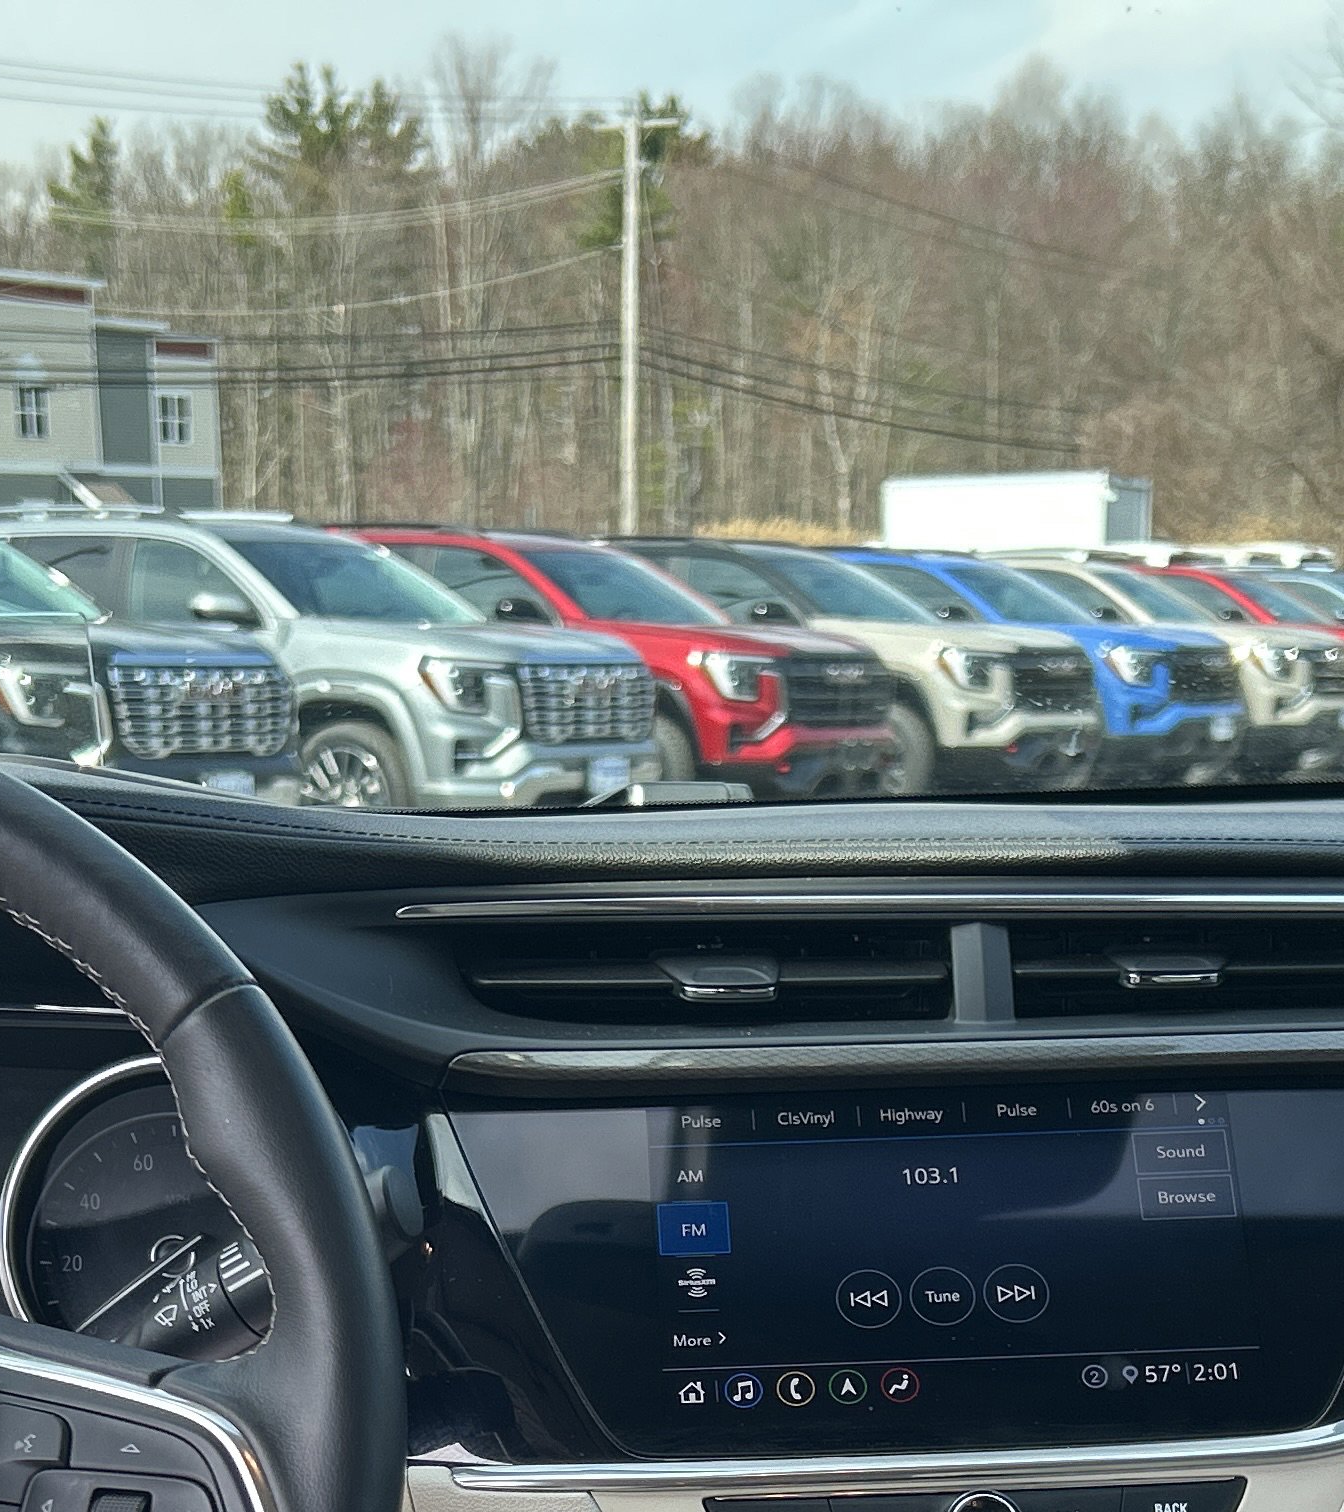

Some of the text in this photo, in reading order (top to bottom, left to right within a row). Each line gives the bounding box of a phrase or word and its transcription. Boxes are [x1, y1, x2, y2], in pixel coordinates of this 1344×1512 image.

[996, 1103, 1038, 1117] Pulse
[1090, 1099, 1155, 1114] 60s on 6
[681, 1114, 722, 1129] Pulse
[777, 1110, 835, 1127] ClsVinyl
[879, 1108, 944, 1125] Highway
[1156, 1144, 1205, 1159] Sound
[133, 1153, 154, 1172] 60
[677, 1170, 704, 1184] AM
[902, 1167, 959, 1185] 103.1
[79, 1192, 101, 1211] 40
[1157, 1190, 1216, 1205] Browse
[681, 1223, 707, 1238] FM
[61, 1254, 83, 1273] 20
[191, 1287, 208, 1303] INT
[924, 1290, 960, 1304] Tune
[192, 1301, 211, 1318] OFF
[672, 1334, 712, 1348] More
[1090, 1371, 1100, 1383] 2
[1193, 1363, 1239, 1381] 2:01
